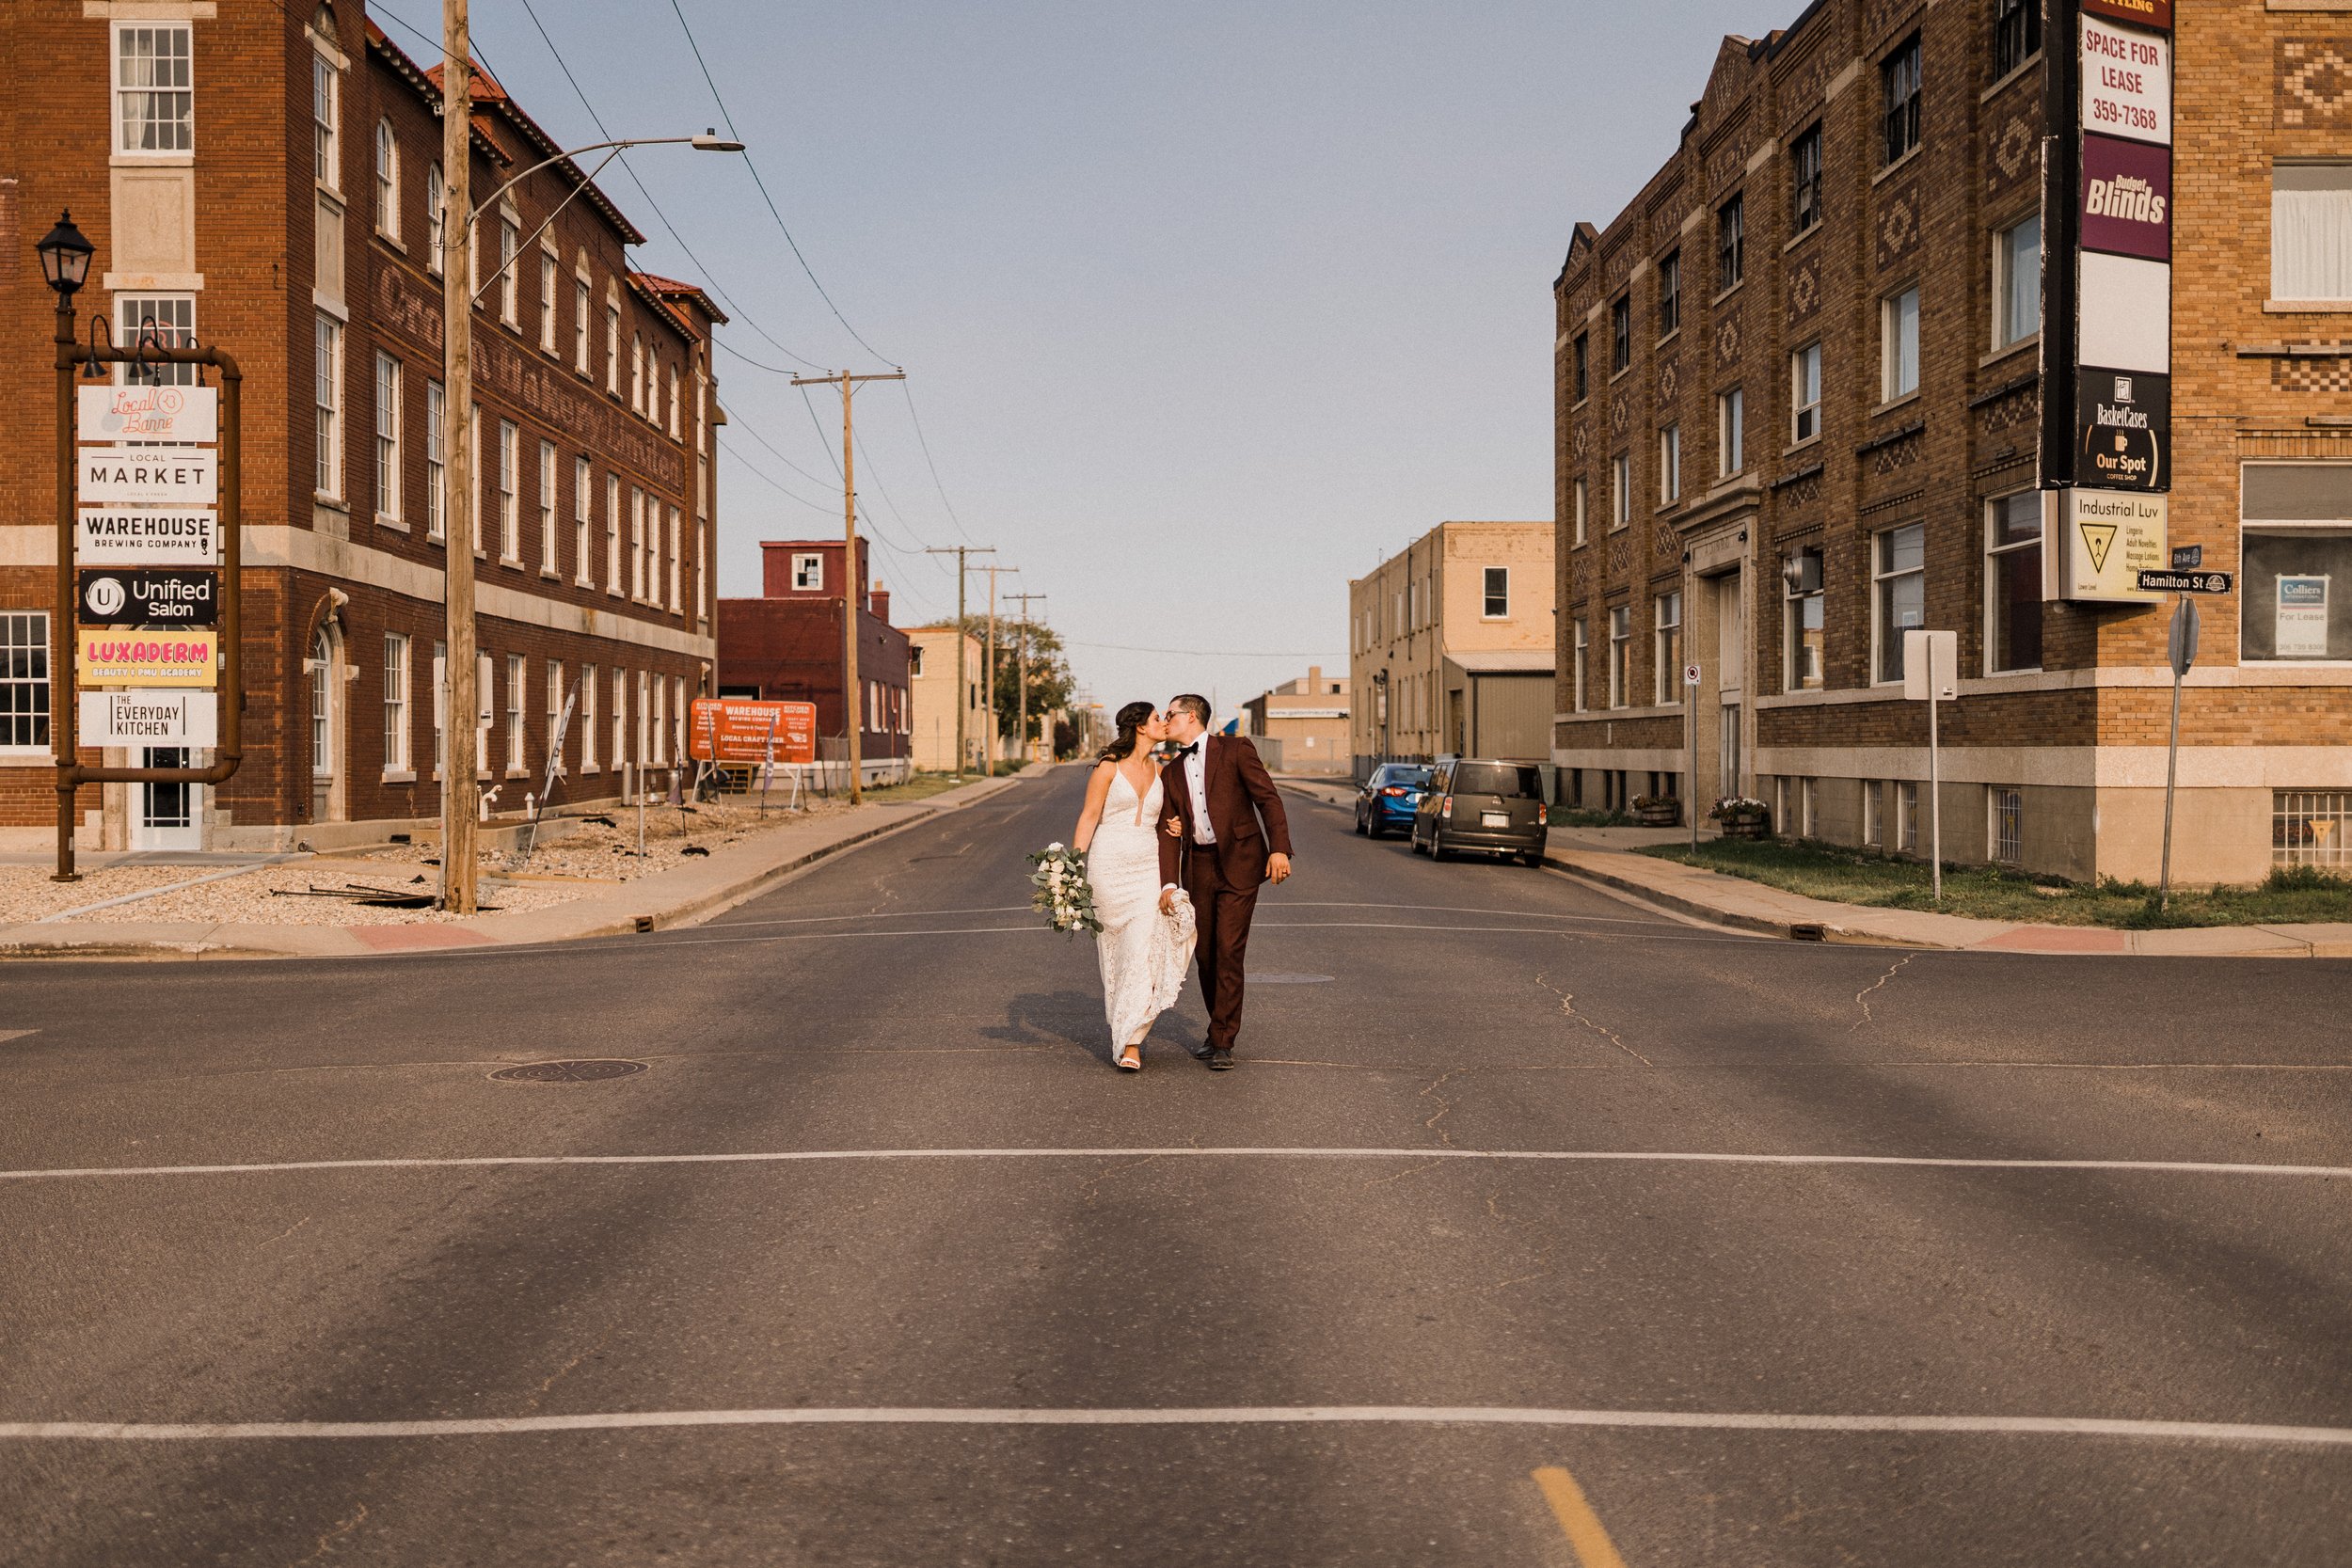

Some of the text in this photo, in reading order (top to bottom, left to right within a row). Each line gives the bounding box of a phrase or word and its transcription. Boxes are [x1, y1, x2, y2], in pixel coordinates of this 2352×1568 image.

[2101, 0, 2153, 13] LING
[2087, 29, 2159, 66] SPACE FOR
[2102, 65, 2143, 94] LEASE
[2093, 97, 2156, 130] 359-7368
[2115, 174, 2147, 192] Budget
[2086, 178, 2166, 224] Blinds
[380, 264, 491, 381] Cron
[111, 388, 157, 415] Local
[2097, 403, 2148, 429] BasketCases
[2096, 452, 2147, 474] Our Spot
[90, 467, 205, 484] MARKET
[2079, 499, 2159, 518] Industrial Luv
[86, 516, 210, 536] WAREHOUSE
[2126, 525, 2143, 536] Lingerie
[95, 539, 197, 548] BREWING COMPANY
[2126, 538, 2157, 548] Adult Novelties
[2126, 551, 2160, 562] Massage Lotions
[2183, 552, 2191, 563] Ave
[133, 578, 210, 601] Unified
[2142, 574, 2204, 589] Hamilton St
[2284, 583, 2321, 594] Colliers
[97, 588, 111, 606] U
[148, 600, 194, 617] Salon
[2280, 612, 2325, 621] For Lease
[87, 641, 209, 664] LUXADERM
[92, 668, 128, 677] BEAUTY
[137, 668, 157, 677] PMU
[160, 668, 202, 677] ACADEMY
[117, 695, 132, 705] THE
[117, 706, 179, 721] EVERYDAY
[725, 706, 781, 717] WAREHOUSE
[117, 721, 168, 736] KITCHEN
